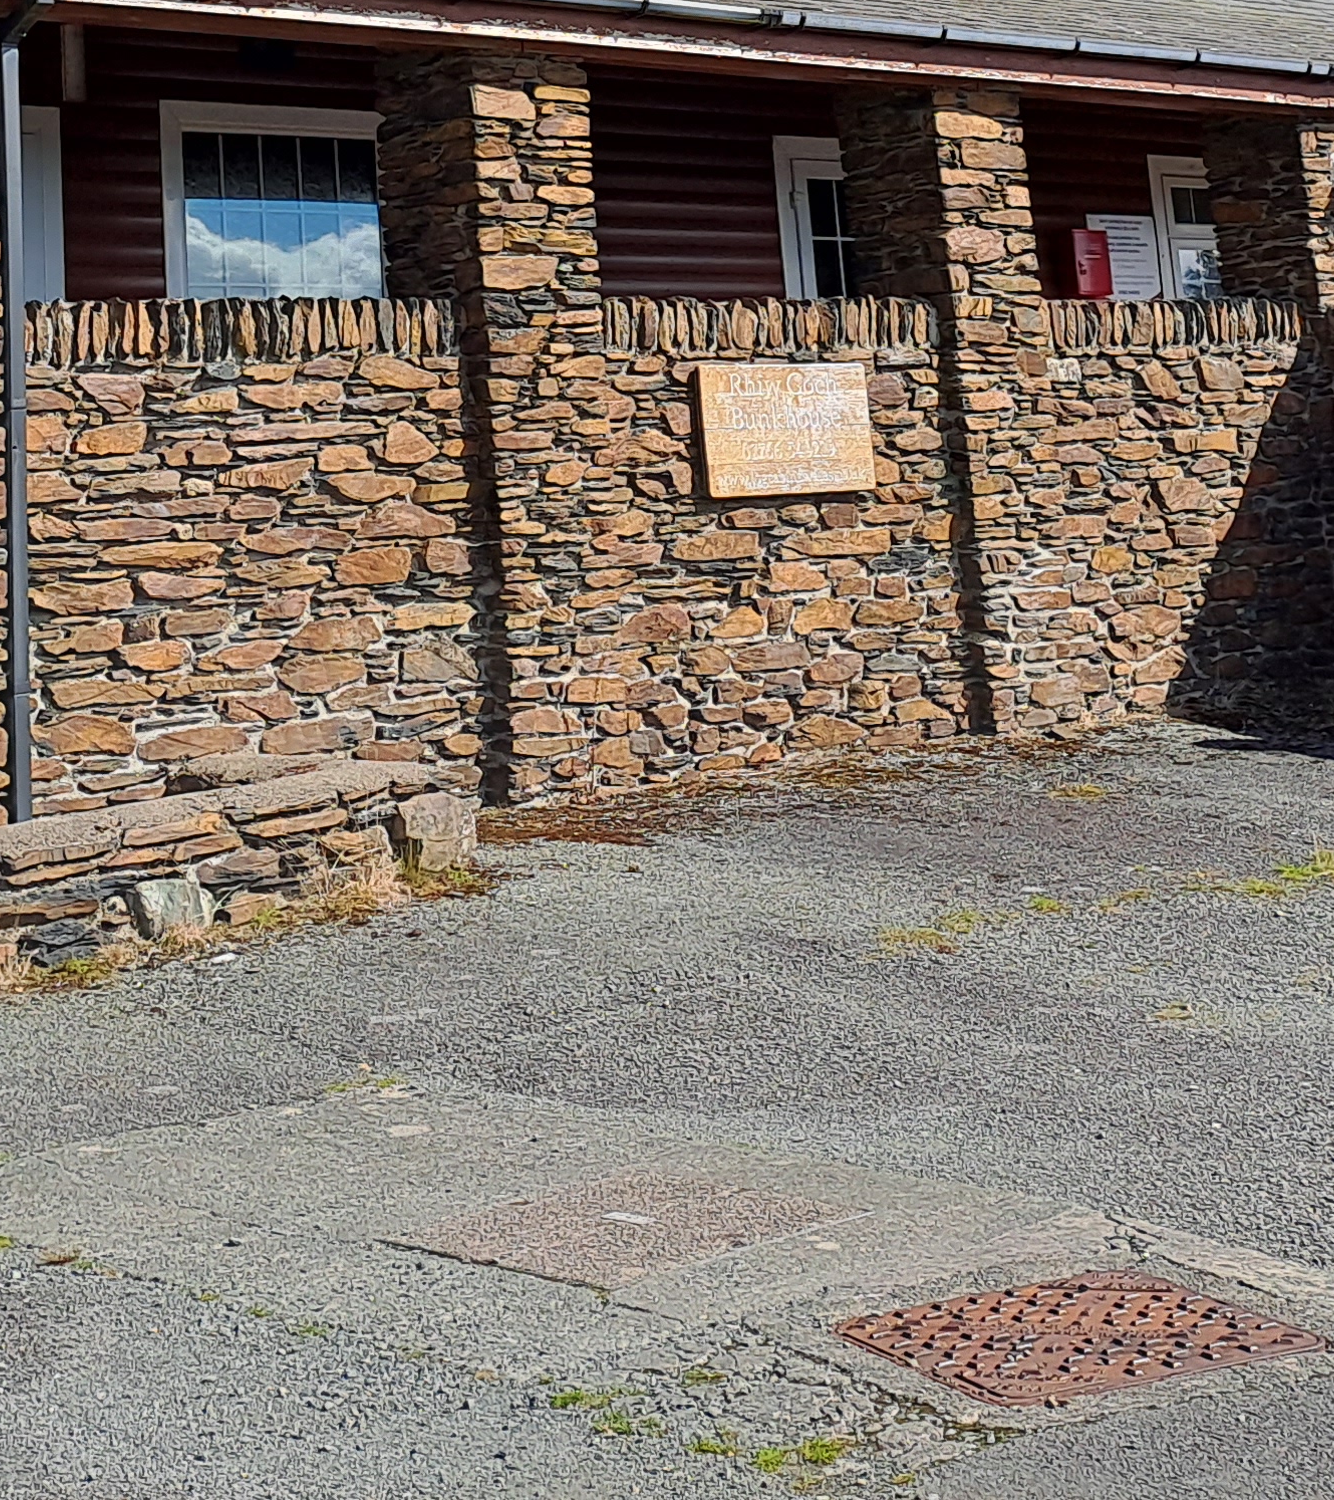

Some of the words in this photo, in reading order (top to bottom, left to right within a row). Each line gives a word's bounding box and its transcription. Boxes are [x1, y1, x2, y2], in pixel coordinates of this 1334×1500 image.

[729, 372, 783, 399] Rhiw
[786, 371, 839, 396] Goch
[731, 403, 844, 431] Bunkhouse
